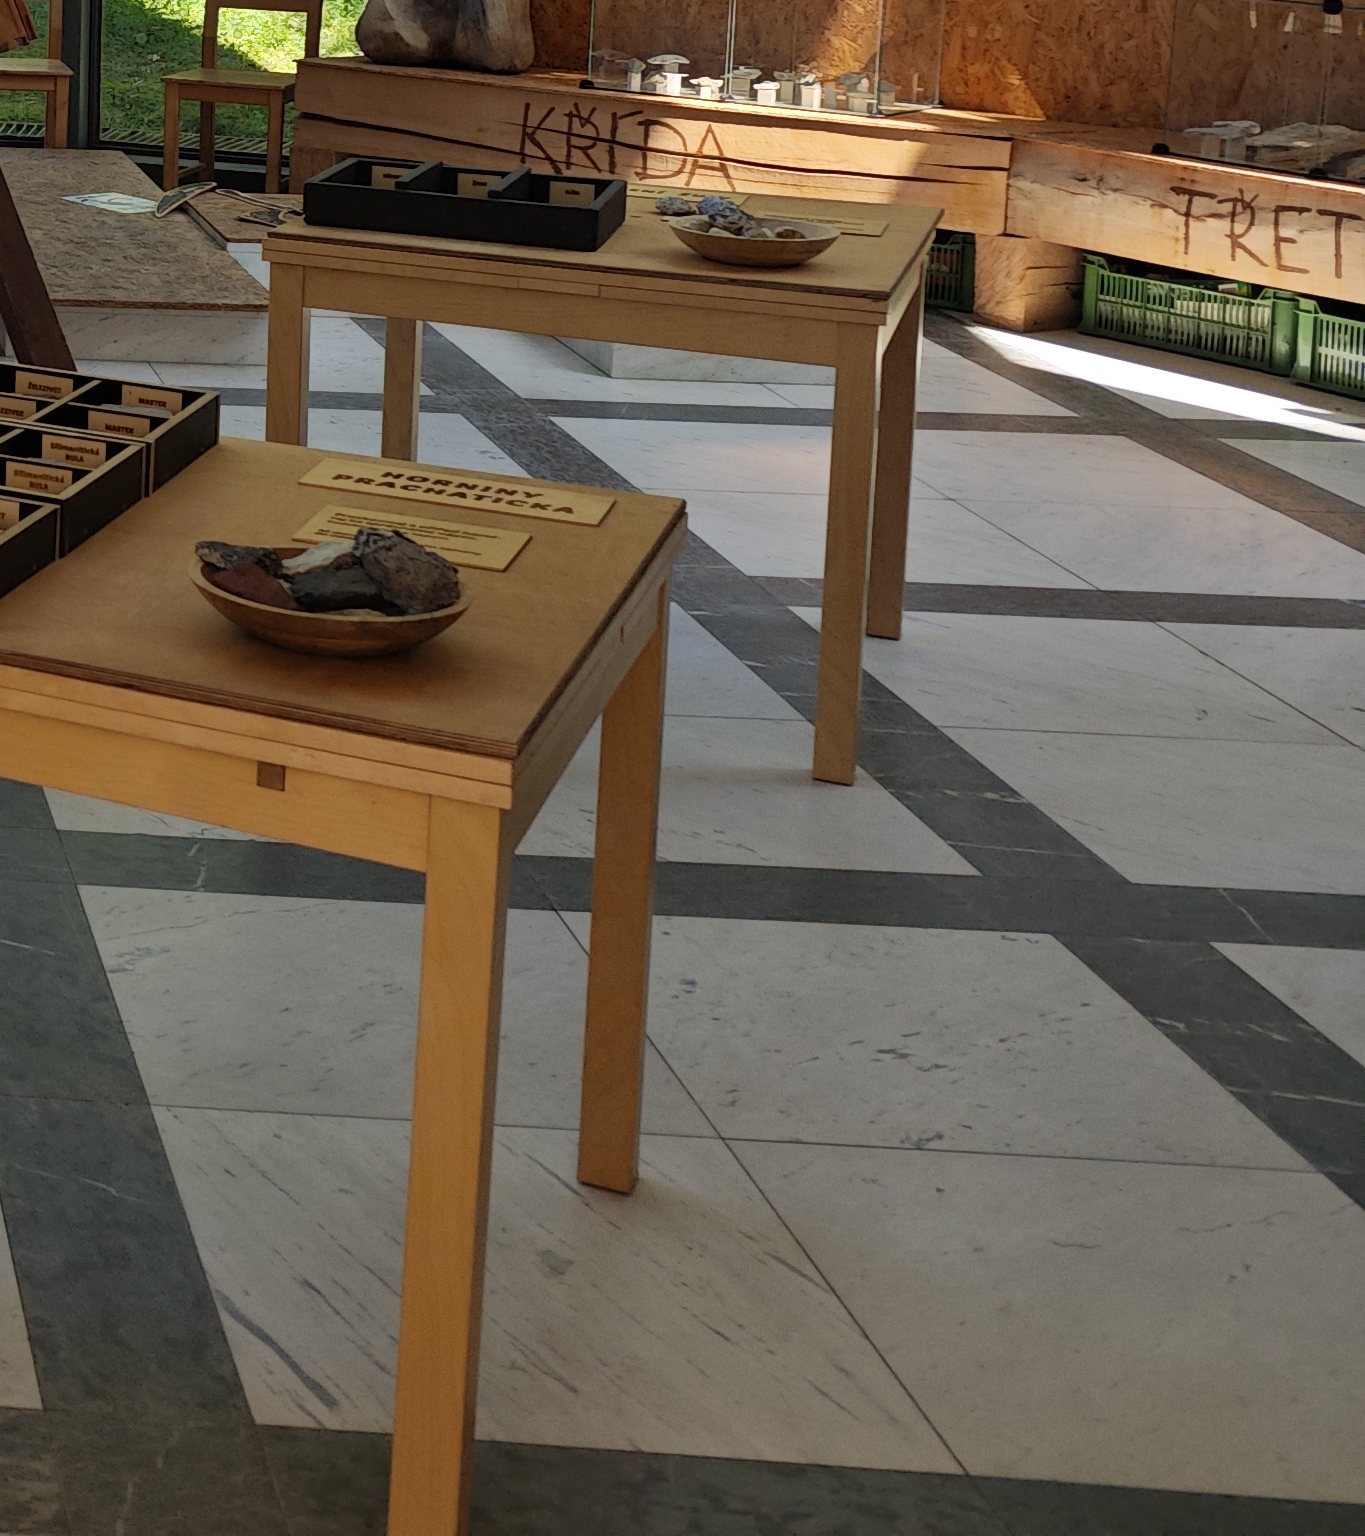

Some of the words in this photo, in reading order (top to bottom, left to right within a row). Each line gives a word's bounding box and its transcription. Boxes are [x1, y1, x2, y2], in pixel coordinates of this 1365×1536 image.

[520, 102, 737, 192] KŘÍDA
[1169, 187, 1365, 279] TŘET
[138, 397, 167, 408] MASTEK
[105, 423, 135, 434] MASTEK
[65, 453, 85, 463] RULA
[29, 480, 49, 491] RULA
[331, 473, 575, 515] PRACHATICKA
[380, 471, 545, 499] HORNINY
